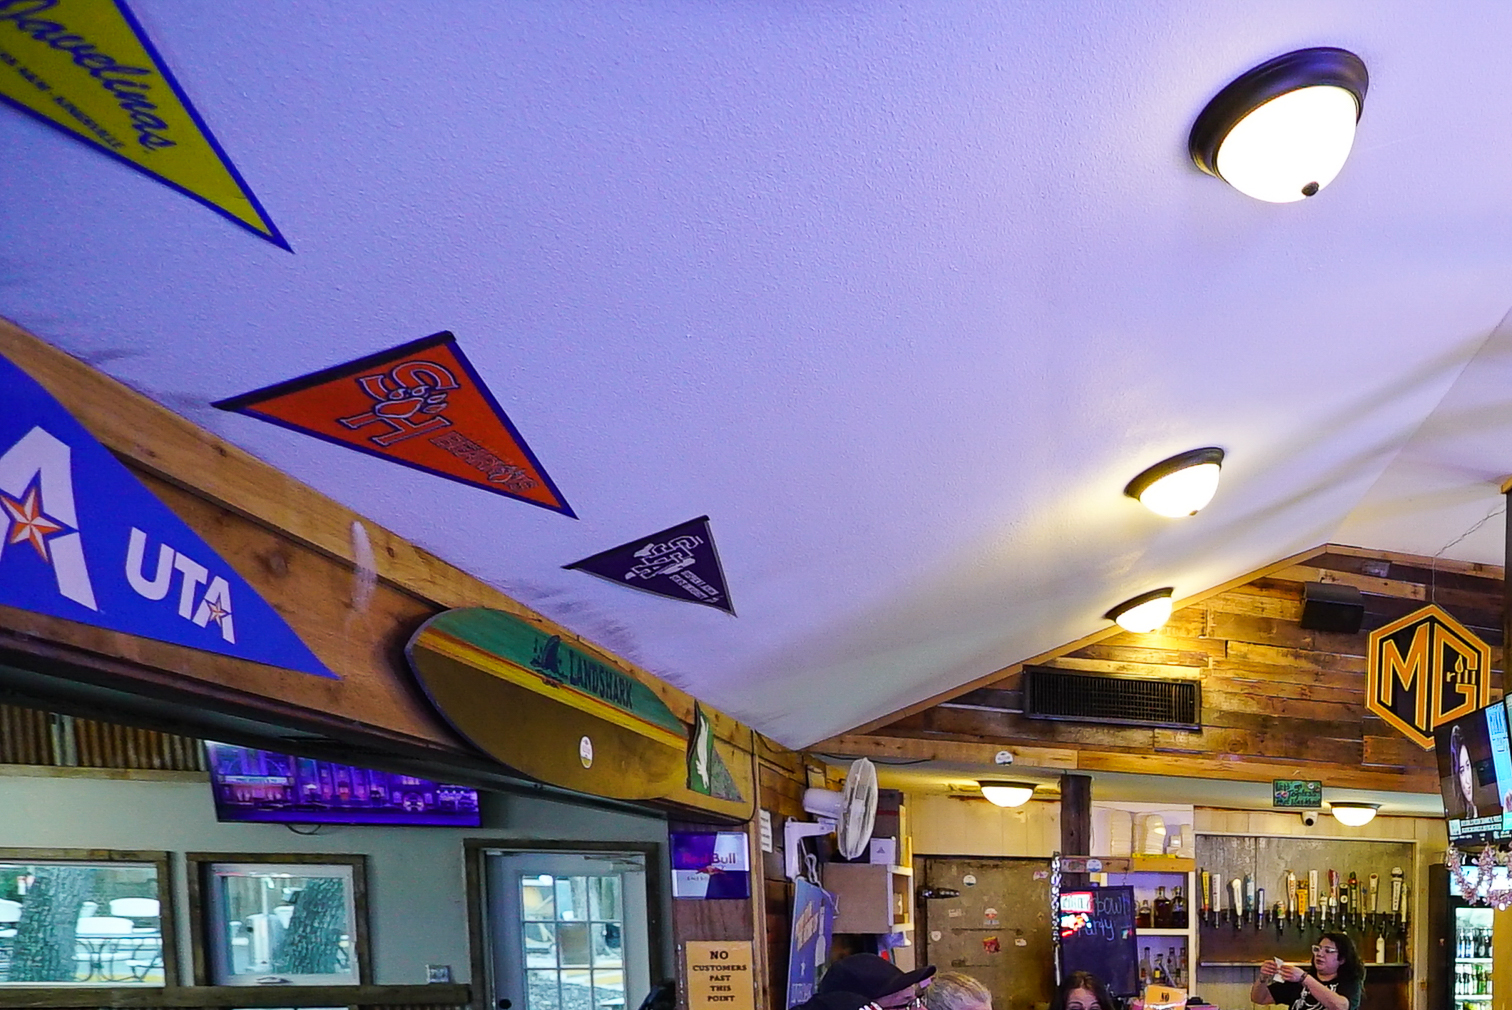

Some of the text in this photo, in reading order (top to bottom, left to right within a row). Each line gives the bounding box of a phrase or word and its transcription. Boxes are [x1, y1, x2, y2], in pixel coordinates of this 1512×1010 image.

[125, 527, 236, 645] UTA
[569, 649, 632, 709] LANDSHARK
[713, 853, 736, 864] Bull
[710, 950, 729, 960] NO
